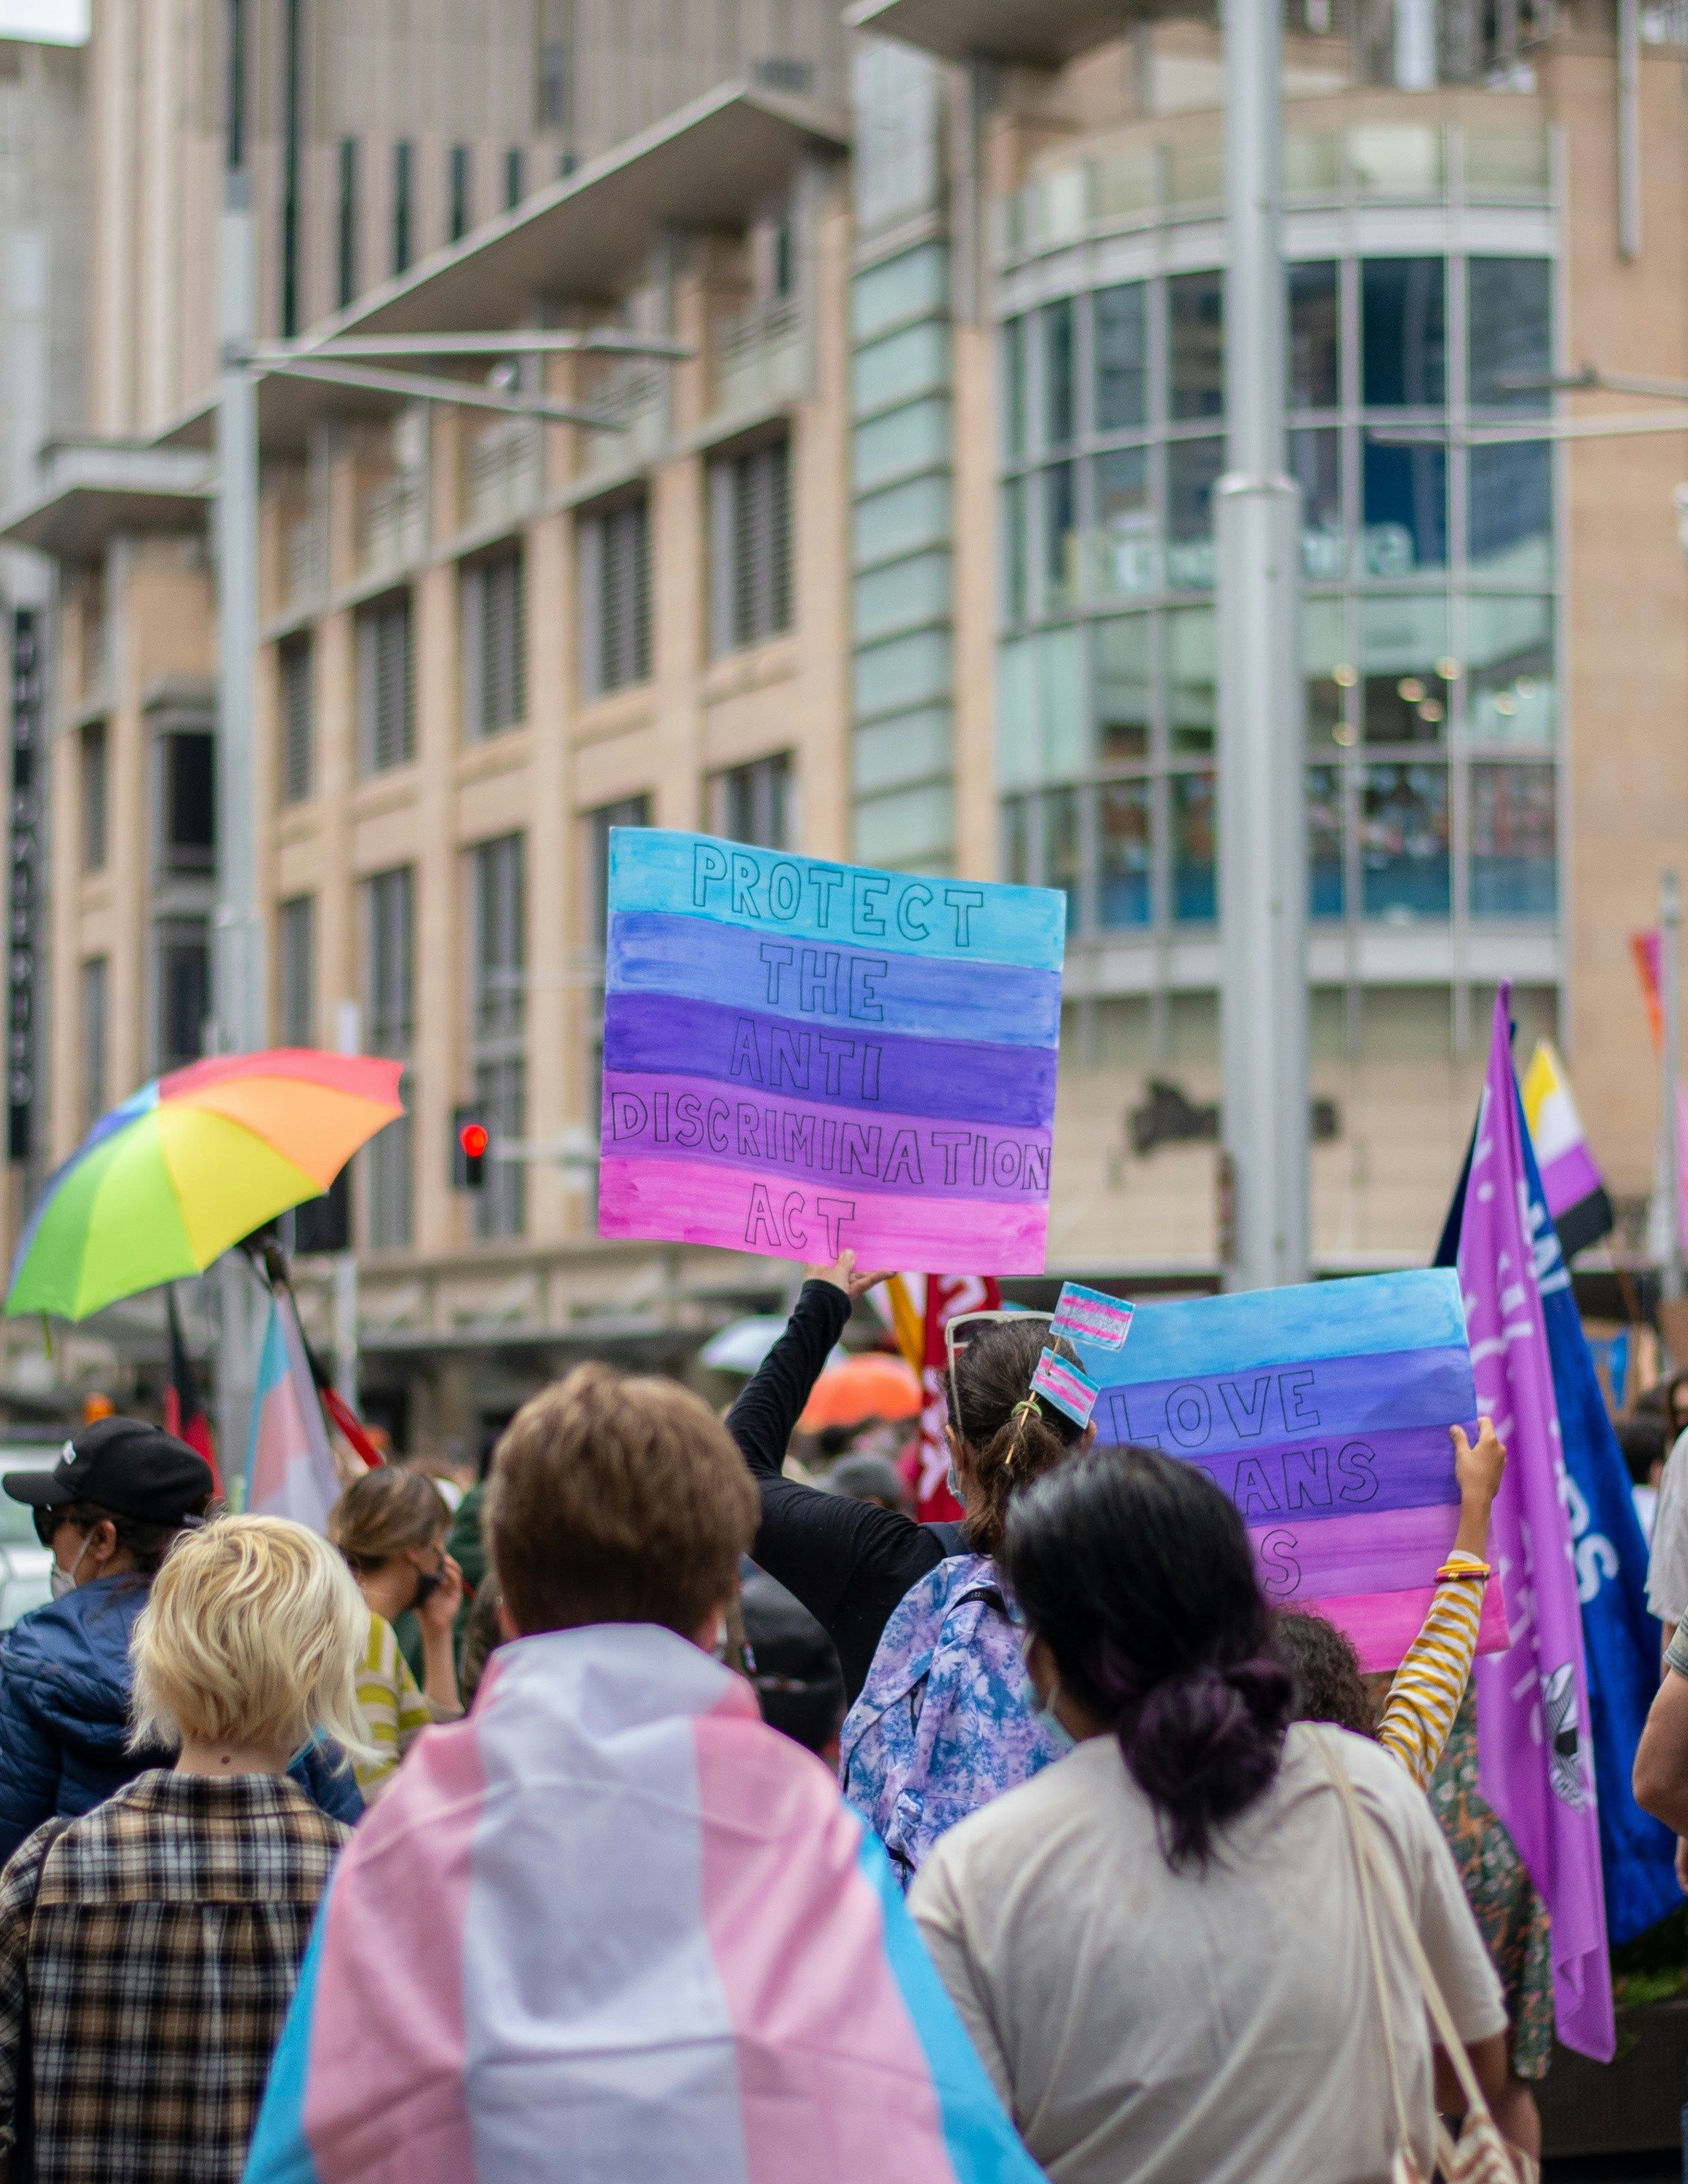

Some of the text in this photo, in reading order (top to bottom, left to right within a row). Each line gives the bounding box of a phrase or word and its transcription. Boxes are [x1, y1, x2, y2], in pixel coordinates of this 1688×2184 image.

[693, 843, 984, 947] PROTECT
[760, 943, 888, 1022] THE
[730, 1017, 882, 1101] ANTI
[611, 1091, 1052, 1190] DISCRIMINATION
[744, 1184, 856, 1259] ACT
[1109, 1369, 1320, 1448] LOVE
[1199, 1441, 1379, 1515] ANS
